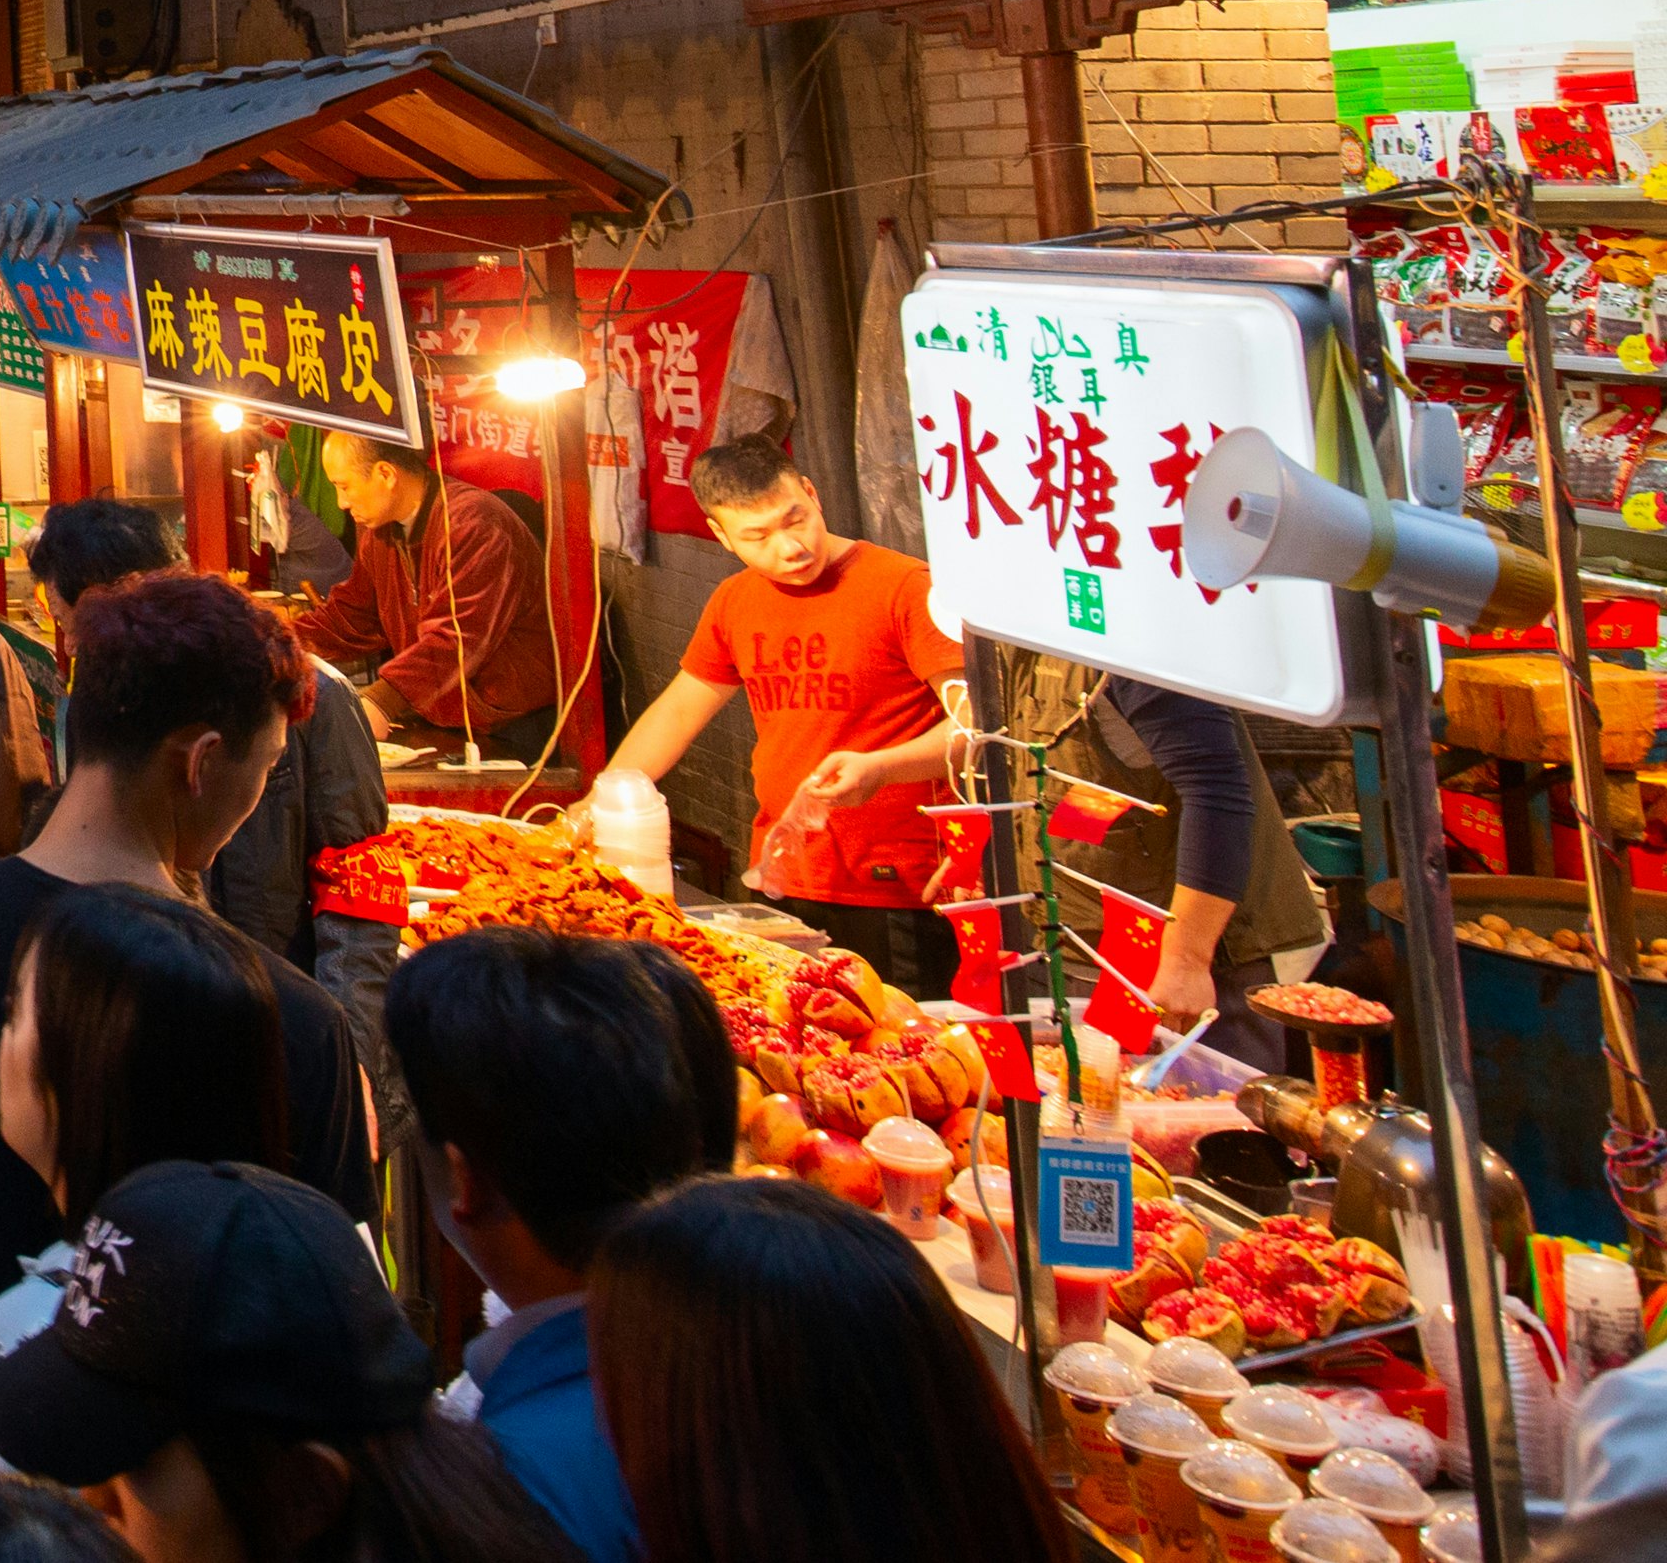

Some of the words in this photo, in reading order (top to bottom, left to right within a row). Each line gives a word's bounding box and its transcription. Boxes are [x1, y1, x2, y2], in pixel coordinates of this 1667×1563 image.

[145, 279, 394, 417] 麻辣豆腐皮
[976, 305, 1011, 362] 清
[1113, 312, 1150, 376] 真
[1028, 363, 1109, 416] 銀耳
[751, 631, 828, 675] Lee
[744, 672, 855, 713] RIDERS
